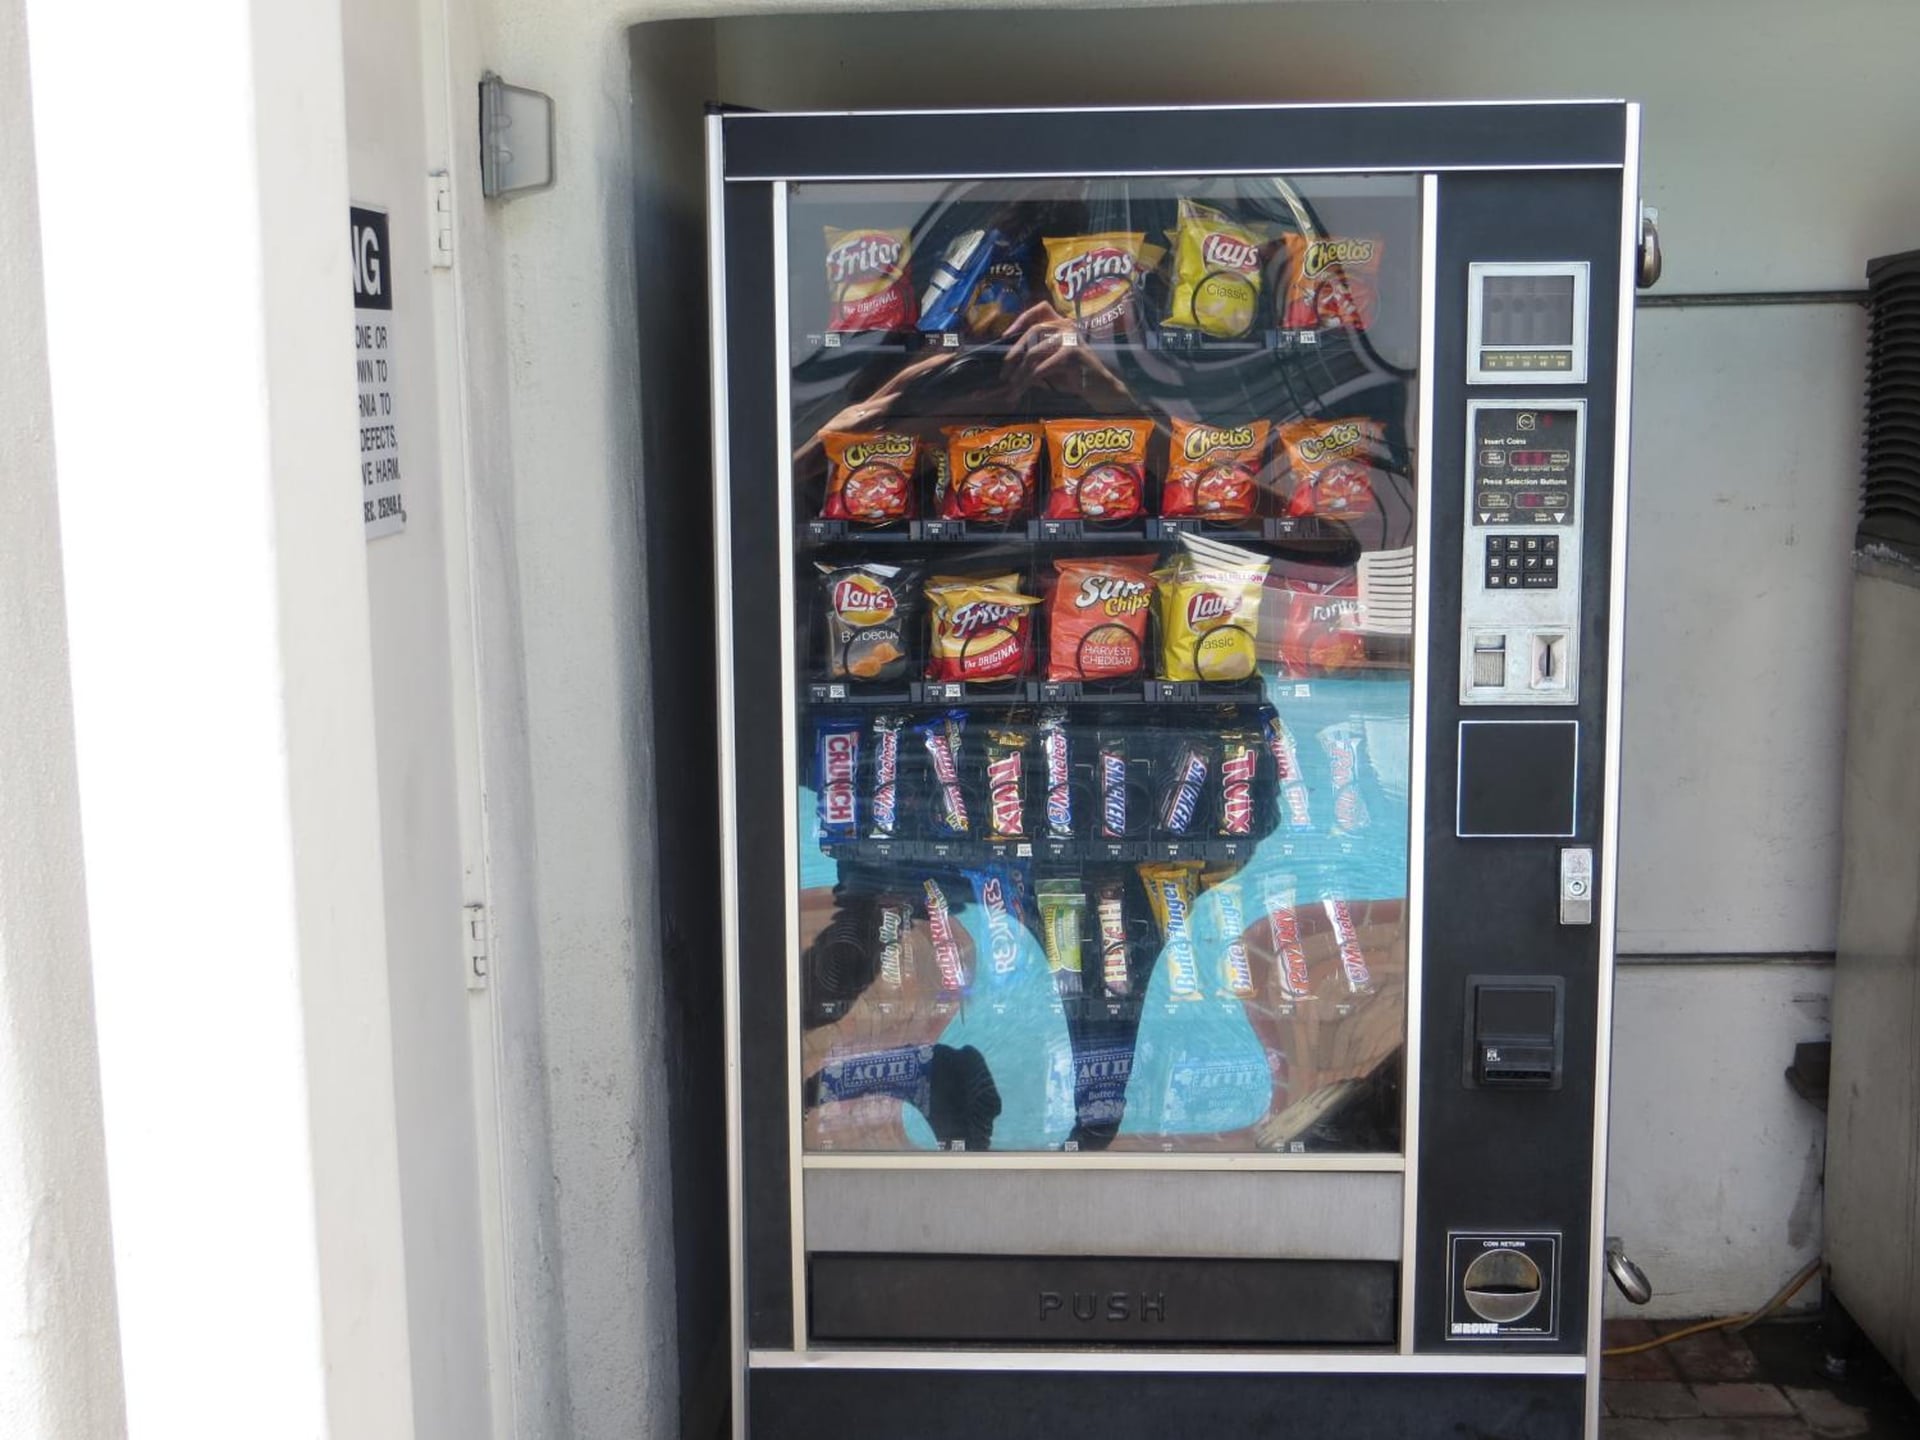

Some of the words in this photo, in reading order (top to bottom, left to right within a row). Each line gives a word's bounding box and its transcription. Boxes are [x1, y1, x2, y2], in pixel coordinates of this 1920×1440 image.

[827, 238, 902, 283] Fritos
[1305, 240, 1374, 278] Cheetos
[1055, 250, 1133, 300] Fritos
[376, 326, 387, 349] OR
[376, 360, 387, 382] TO
[379, 392, 391, 416] TO
[846, 435, 912, 468] Cheetos
[966, 432, 1034, 469] Cheetos
[1065, 428, 1132, 465] Cheetos
[1186, 426, 1254, 460] Cheetos
[1302, 424, 1361, 462] Cheetos
[1509, 540, 1519, 549] 2
[1527, 540, 1536, 549] 3
[1490, 559, 1499, 567] 5
[1509, 559, 1518, 567] 6
[1527, 559, 1536, 567] 7
[1491, 576, 1499, 584] 9
[1509, 576, 1518, 584] 0
[842, 583, 890, 613] Lay's
[1105, 594, 1150, 616] Chips
[952, 602, 1023, 638] Fritos
[978, 642, 1019, 667] ORIGINAL
[1083, 656, 1131, 666] CHEDDAR
[1085, 646, 1131, 656] HARVEST
[828, 736, 850, 821] CRUNCH
[852, 1063, 886, 1080] ACT
[1080, 1061, 1110, 1079] ACT
[1039, 1291, 1166, 1323] PUSH
